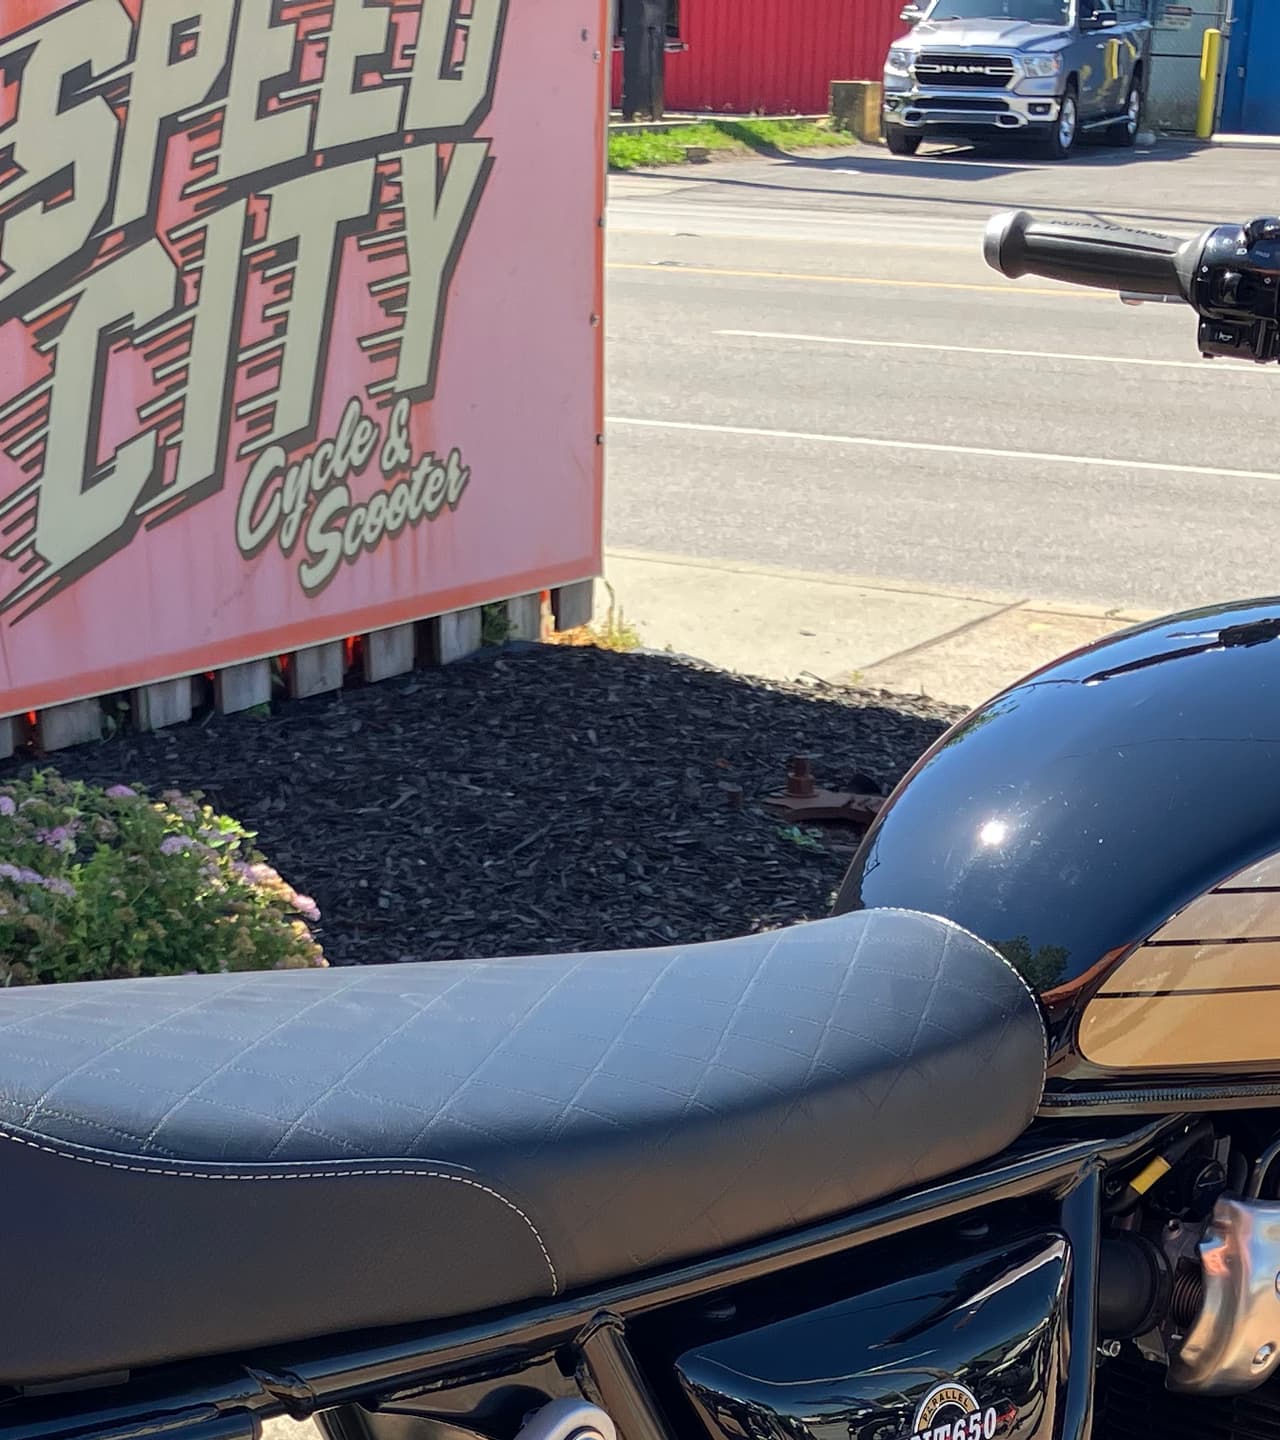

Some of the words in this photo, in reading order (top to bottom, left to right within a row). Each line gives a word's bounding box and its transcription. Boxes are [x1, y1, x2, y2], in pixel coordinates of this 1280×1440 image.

[941, 64, 986, 74] RAM
[235, 398, 376, 558] Cycle
[379, 400, 412, 470] &
[297, 448, 470, 597] Scooter
[922, 1389, 970, 1422] PARALLEL
